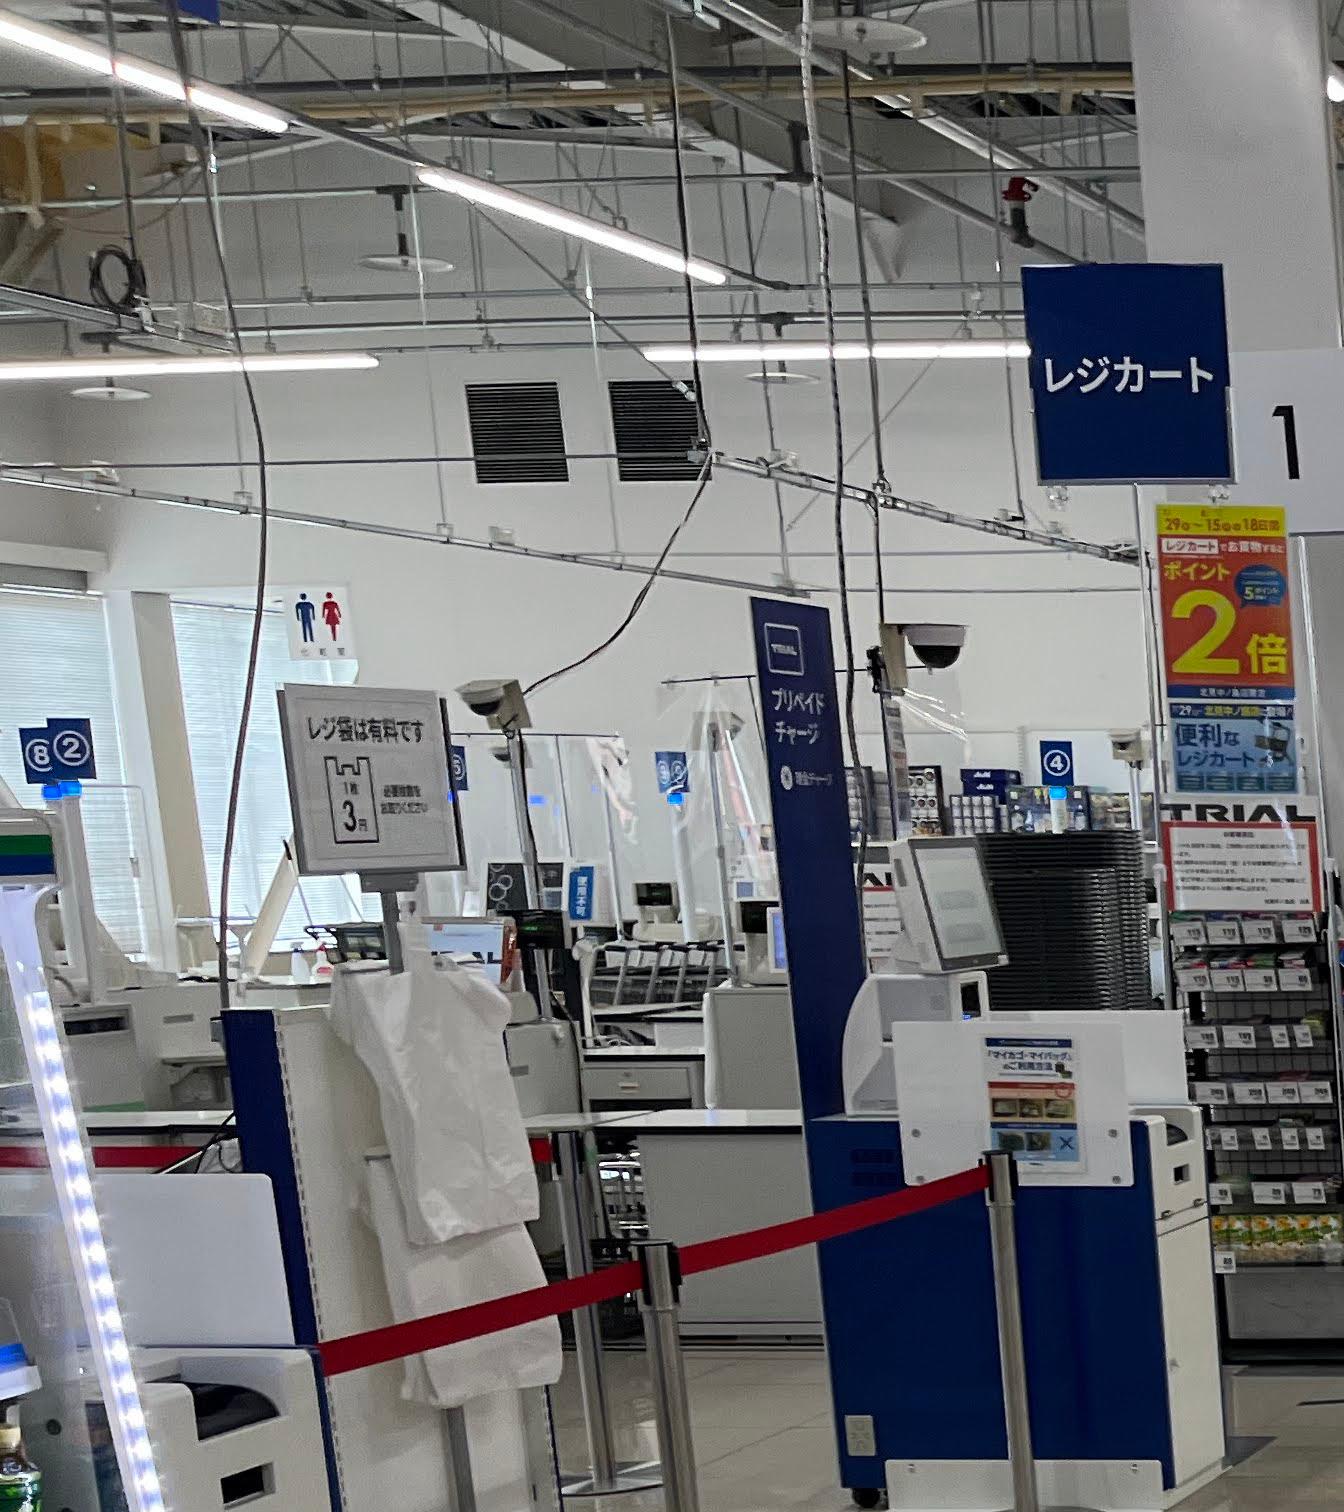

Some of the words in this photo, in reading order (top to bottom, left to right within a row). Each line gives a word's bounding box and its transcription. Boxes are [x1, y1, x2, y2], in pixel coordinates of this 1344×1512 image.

[1045, 356, 1213, 393] レジカート
[1272, 405, 1300, 480] 1
[1164, 560, 1231, 581] ポイント
[772, 688, 824, 715] プリペイド
[308, 716, 424, 743] レジ袋は有料です
[775, 721, 818, 744] チャージ
[1175, 723, 1240, 748] 便利な
[1177, 751, 1254, 767] レジカート
[1160, 804, 1316, 822] TRIAL
